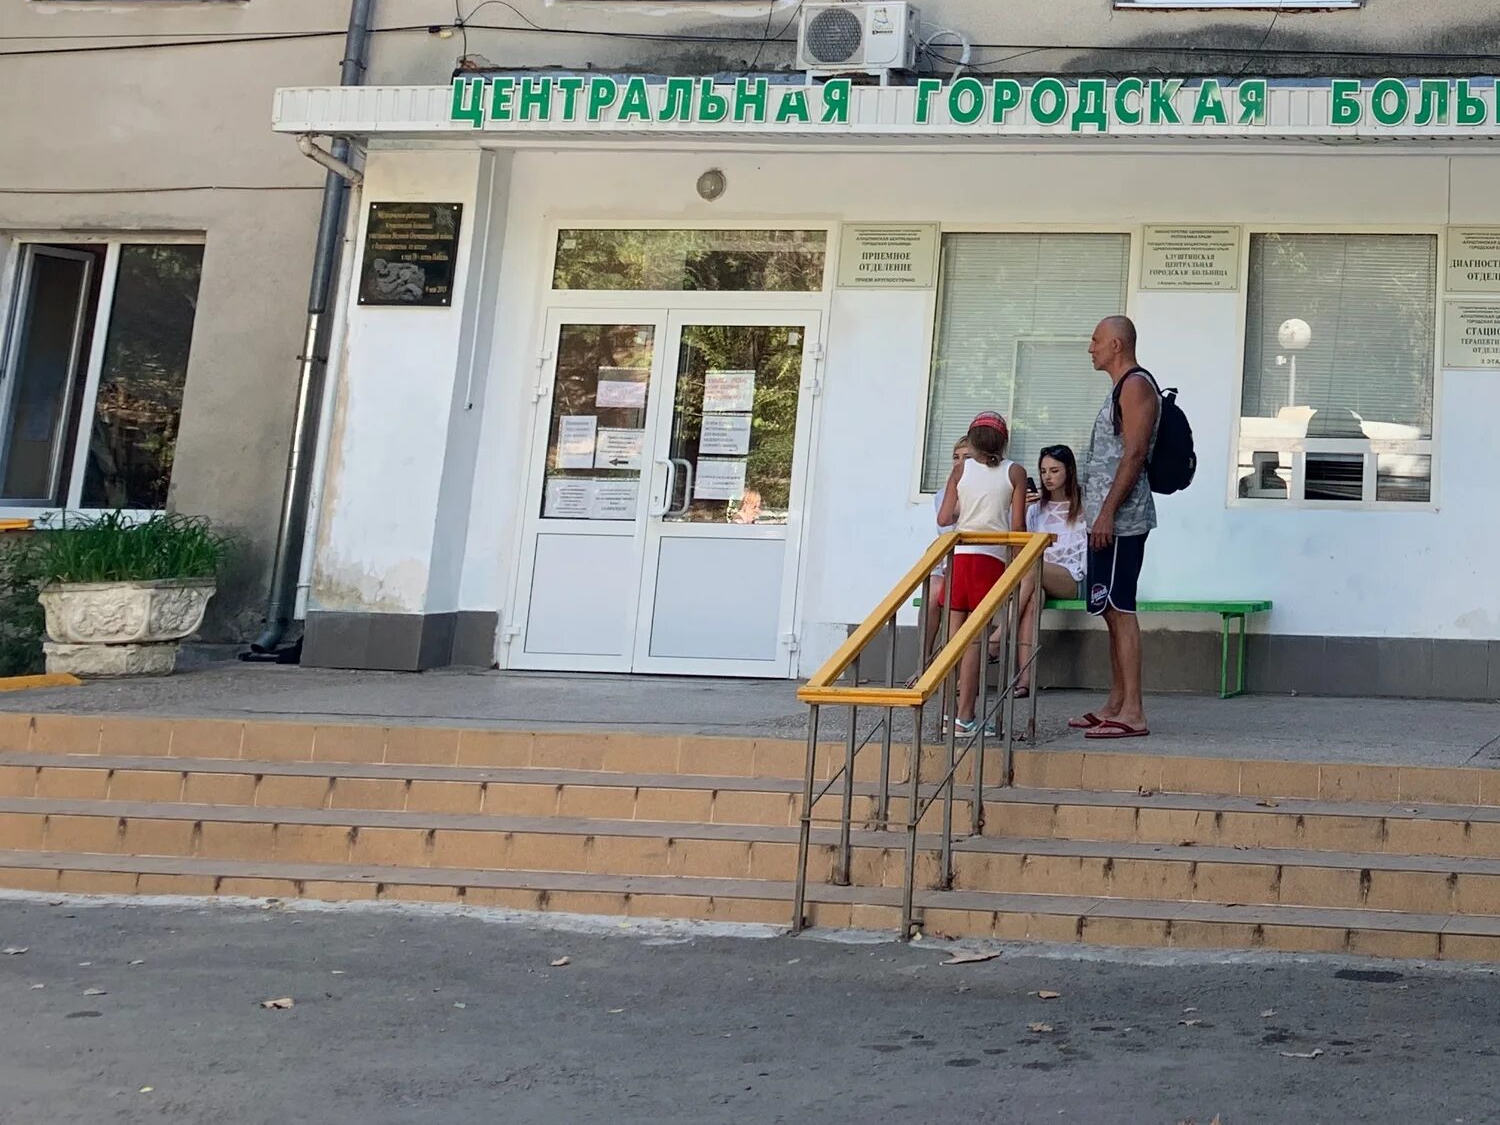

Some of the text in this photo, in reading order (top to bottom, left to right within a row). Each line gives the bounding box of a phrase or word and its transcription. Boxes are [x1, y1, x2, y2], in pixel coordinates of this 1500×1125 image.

[450, 77, 850, 129] ЦЕНТРАЛЬНАЯ
[914, 77, 1270, 133] ГОРОДСКАЯ
[862, 251, 912, 260] ПРИЕМНОЕ
[859, 263, 913, 272] ОТДЕЛЕНИЕ
